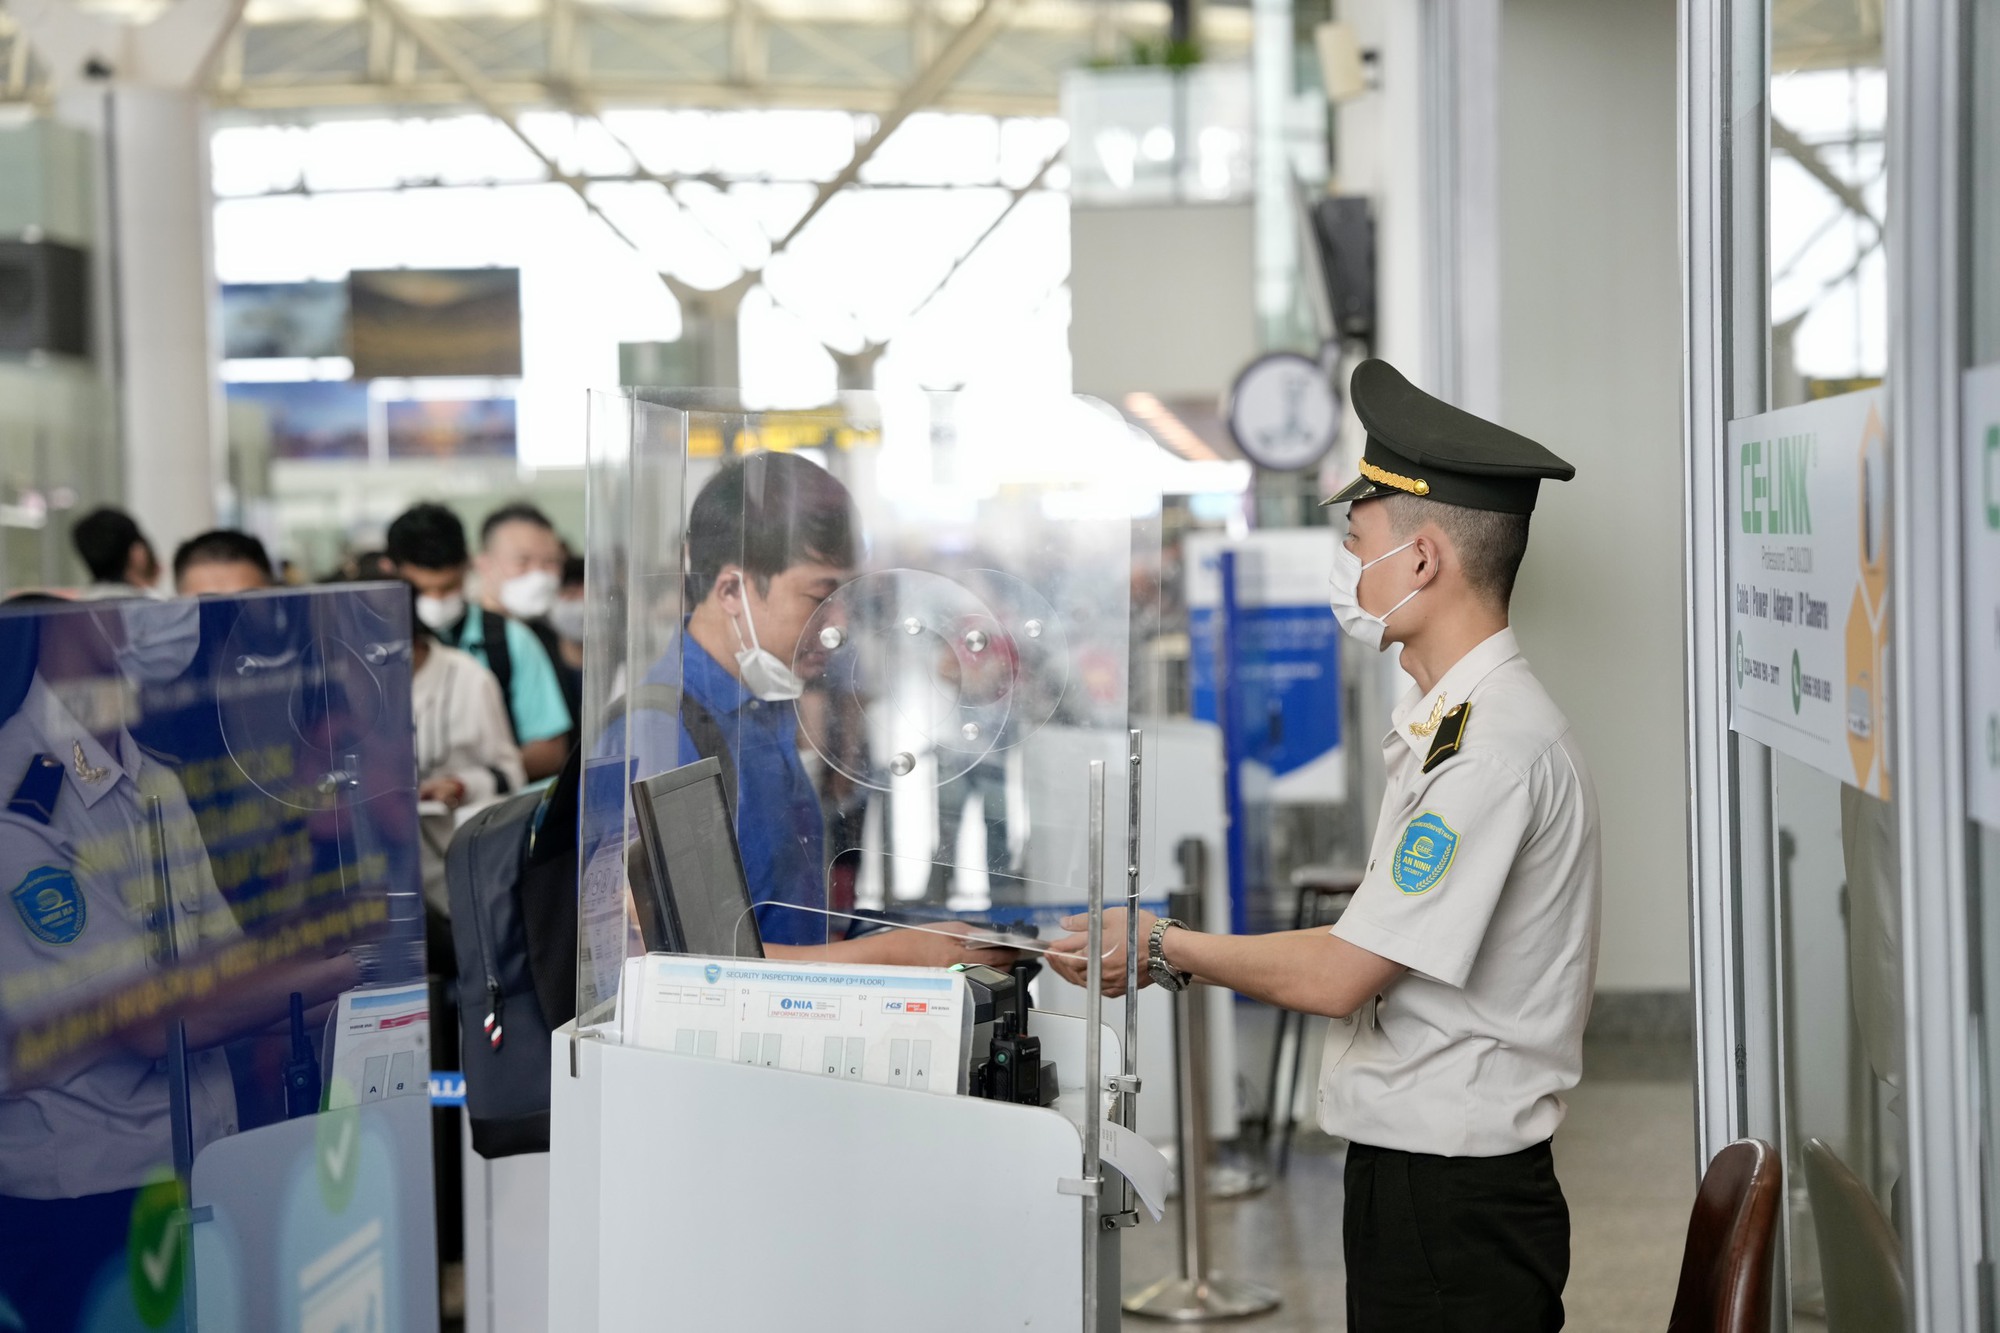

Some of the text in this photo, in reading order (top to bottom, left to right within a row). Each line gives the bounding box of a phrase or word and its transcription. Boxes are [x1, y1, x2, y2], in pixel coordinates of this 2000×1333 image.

[1753, 585, 1768, 619] Power
[1402, 856, 1431, 873] AN NINH
[726, 971, 759, 980] SECURITY
[761, 973, 803, 982] INSPECTION
[805, 975, 828, 983] FLOOR
[859, 978, 885, 986] FLOOR)
[793, 1000, 813, 1010] NIA
[771, 1010, 836, 1019] INFORMATION COUNTER
[828, 1066, 835, 1074] D
[895, 1068, 901, 1076] B
